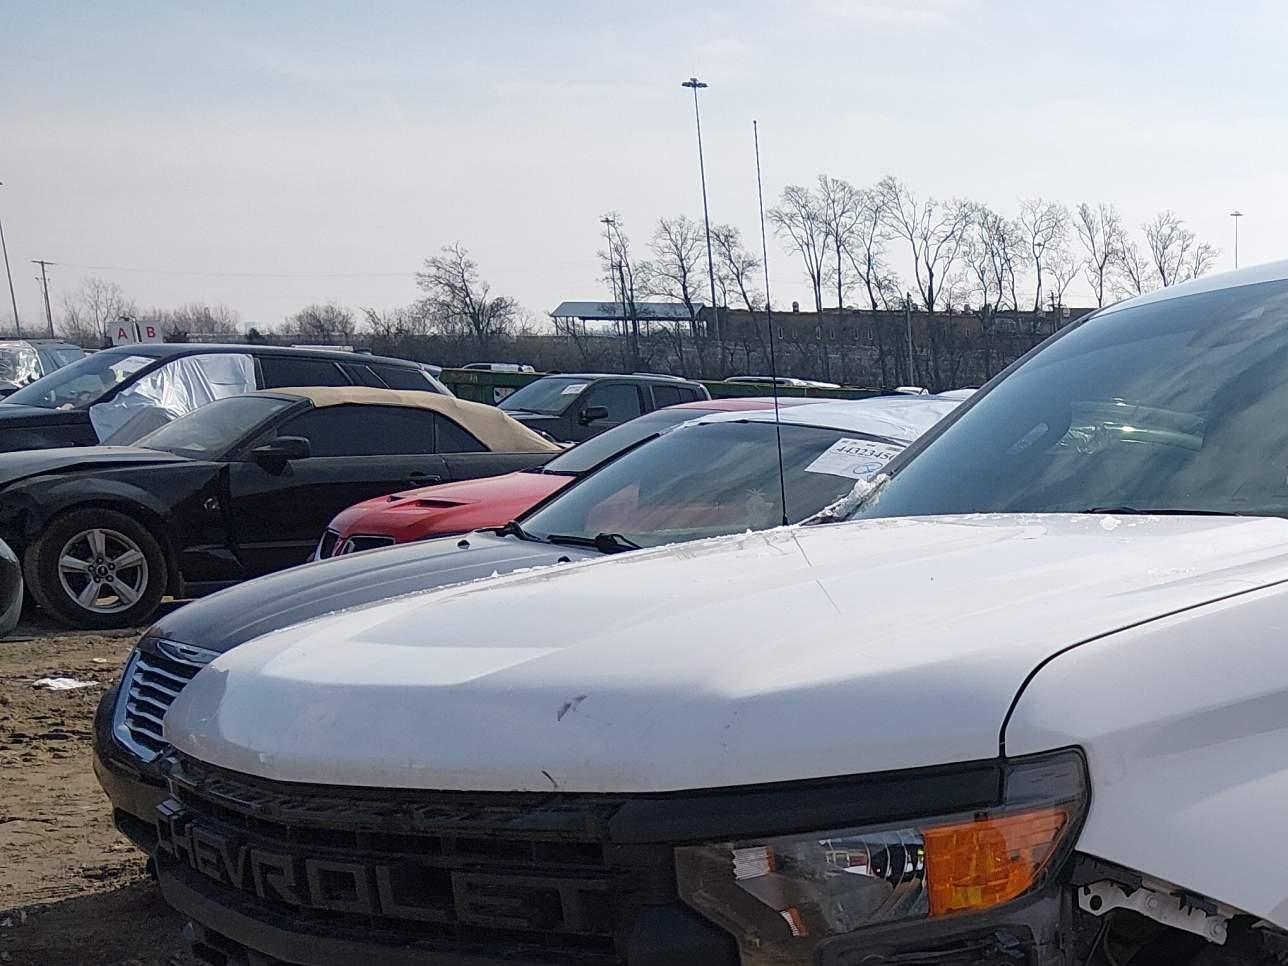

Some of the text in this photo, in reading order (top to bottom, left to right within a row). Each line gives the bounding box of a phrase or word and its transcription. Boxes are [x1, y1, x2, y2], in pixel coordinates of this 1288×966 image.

[117, 327, 129, 340] A
[145, 326, 156, 338] B
[156, 805, 610, 932] CHEVROLET
